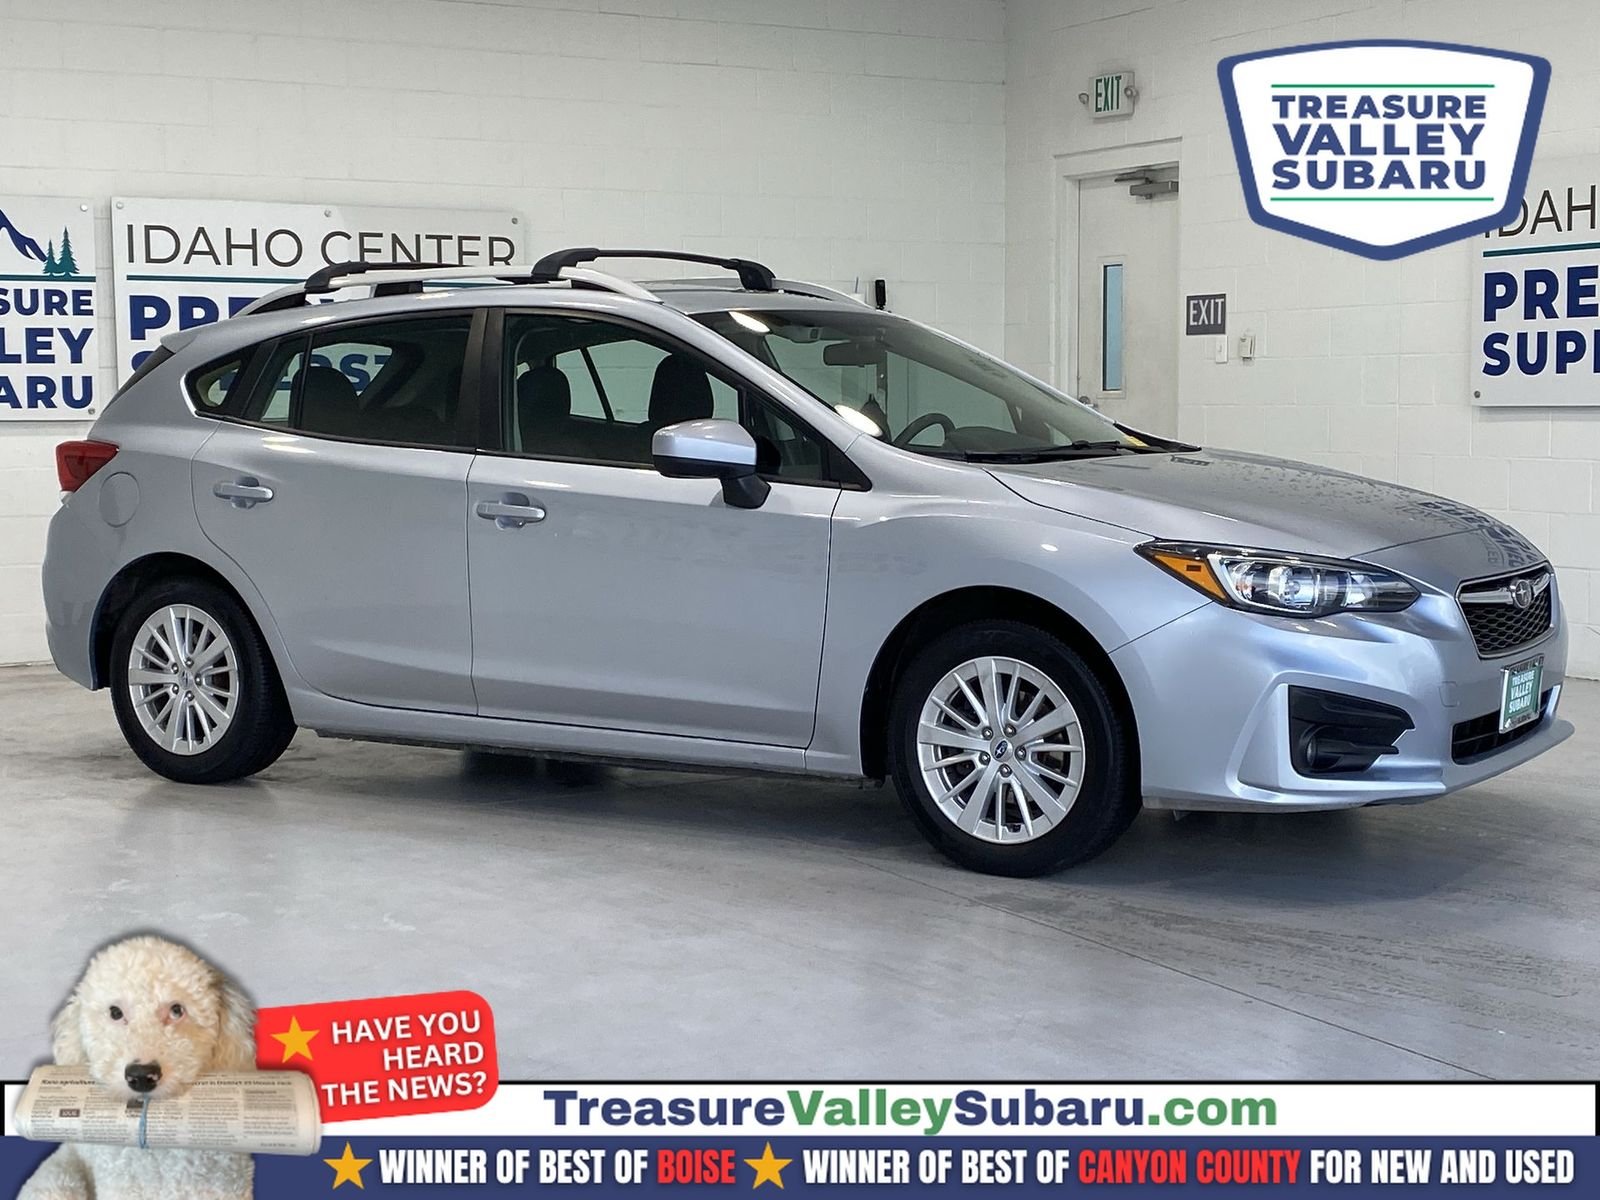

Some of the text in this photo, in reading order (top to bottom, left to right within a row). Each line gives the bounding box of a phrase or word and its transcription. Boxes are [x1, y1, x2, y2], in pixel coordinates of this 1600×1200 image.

[1095, 75, 1122, 112] EXIT
[1485, 185, 1596, 238] DAH
[127, 224, 516, 267] IDAHO CENTER
[1189, 298, 1225, 326] EXIT
[1484, 265, 1599, 322] PRE
[1482, 330, 1600, 376] SUP
[1511, 670, 1535, 686] TREASURE
[1511, 680, 1533, 700] VALLEY
[1509, 694, 1531, 713] SUBARU
